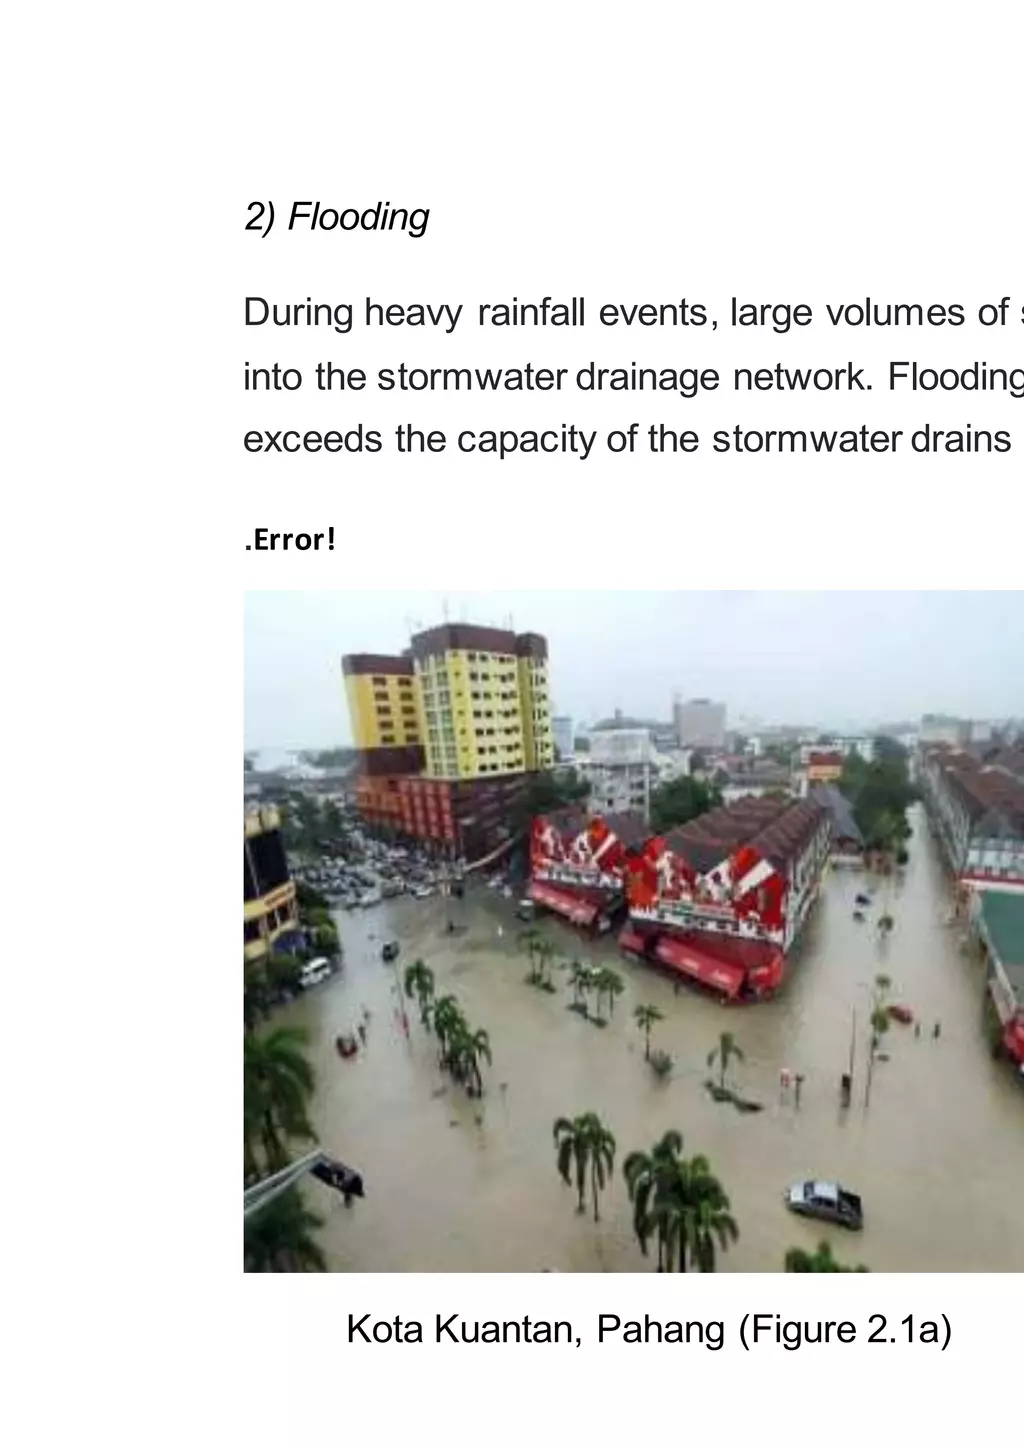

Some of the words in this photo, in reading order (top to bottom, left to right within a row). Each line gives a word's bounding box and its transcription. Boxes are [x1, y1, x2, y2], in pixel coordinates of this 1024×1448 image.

[245, 201, 274, 238] 2)
[288, 202, 430, 238] Flooding
[246, 297, 352, 333] During
[366, 297, 463, 333] heavy
[480, 297, 584, 326] rainfall
[600, 298, 717, 330] events,
[732, 297, 812, 333] large
[826, 297, 965, 326] volumes
[979, 297, 1010, 326] of
[245, 362, 302, 390] into
[316, 362, 366, 390] the
[378, 363, 568, 390] stormwater
[576, 362, 719, 398] drainage
[735, 362, 872, 390] network.
[244, 424, 382, 452] exceeds
[395, 424, 446, 452] the
[458, 424, 597, 460] capacity
[607, 423, 639, 452] of
[648, 424, 699, 452] the
[713, 425, 903, 452] stormwater
[912, 424, 1011, 452] drains
[246, 527, 334, 550] .Error!
[349, 1314, 423, 1343] Kota
[436, 1314, 580, 1348] Kuantan,
[599, 1314, 724, 1350] Pahang
[740, 1314, 856, 1351] (Figure
[868, 1314, 951, 1351] 2.1a)
